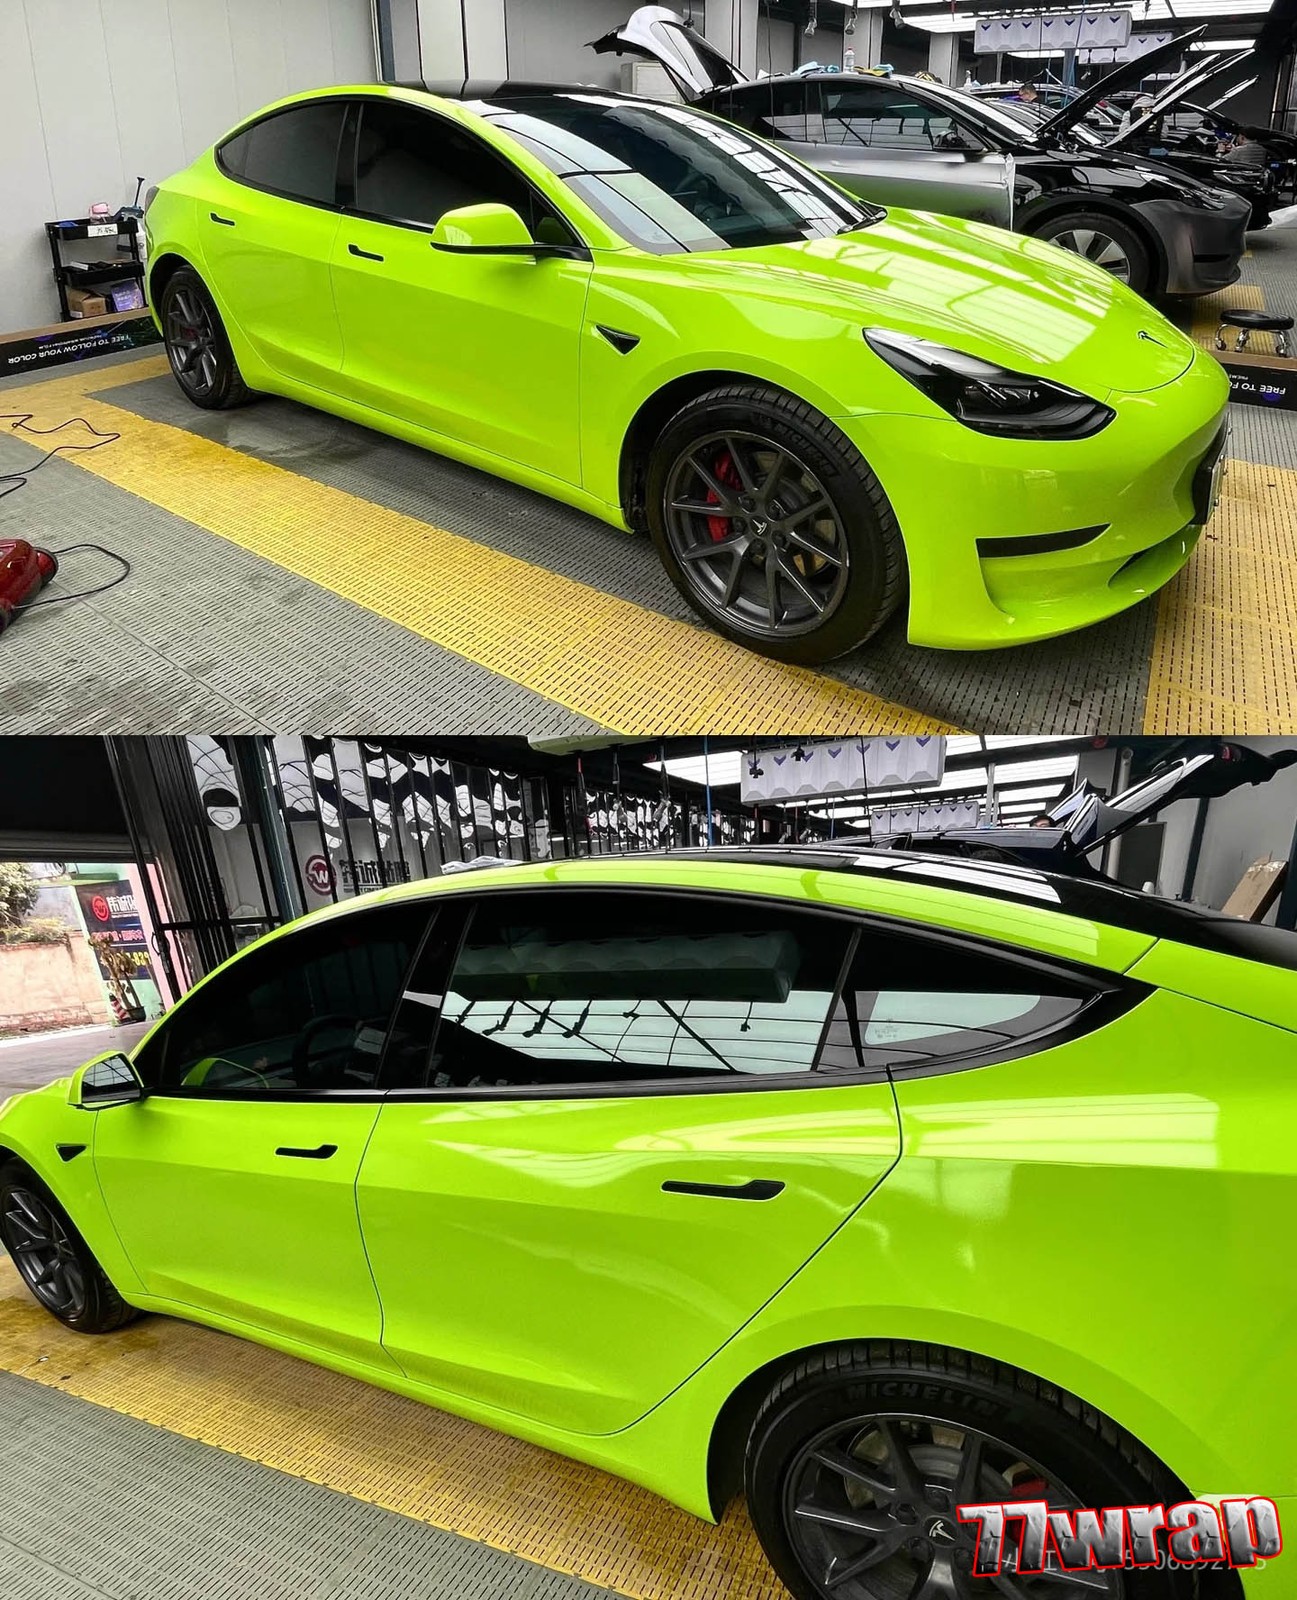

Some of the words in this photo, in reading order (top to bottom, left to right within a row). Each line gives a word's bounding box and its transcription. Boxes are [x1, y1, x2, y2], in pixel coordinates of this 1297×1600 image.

[98, 338, 110, 346] TO
[111, 334, 129, 343] FREE
[63, 340, 97, 353] FOLLOW
[38, 348, 62, 358] YOUR
[8, 353, 37, 364] COLOR
[1241, 382, 1256, 391] TO
[1259, 384, 1286, 395] FREE
[847, 1382, 1000, 1415] MICHELIN
